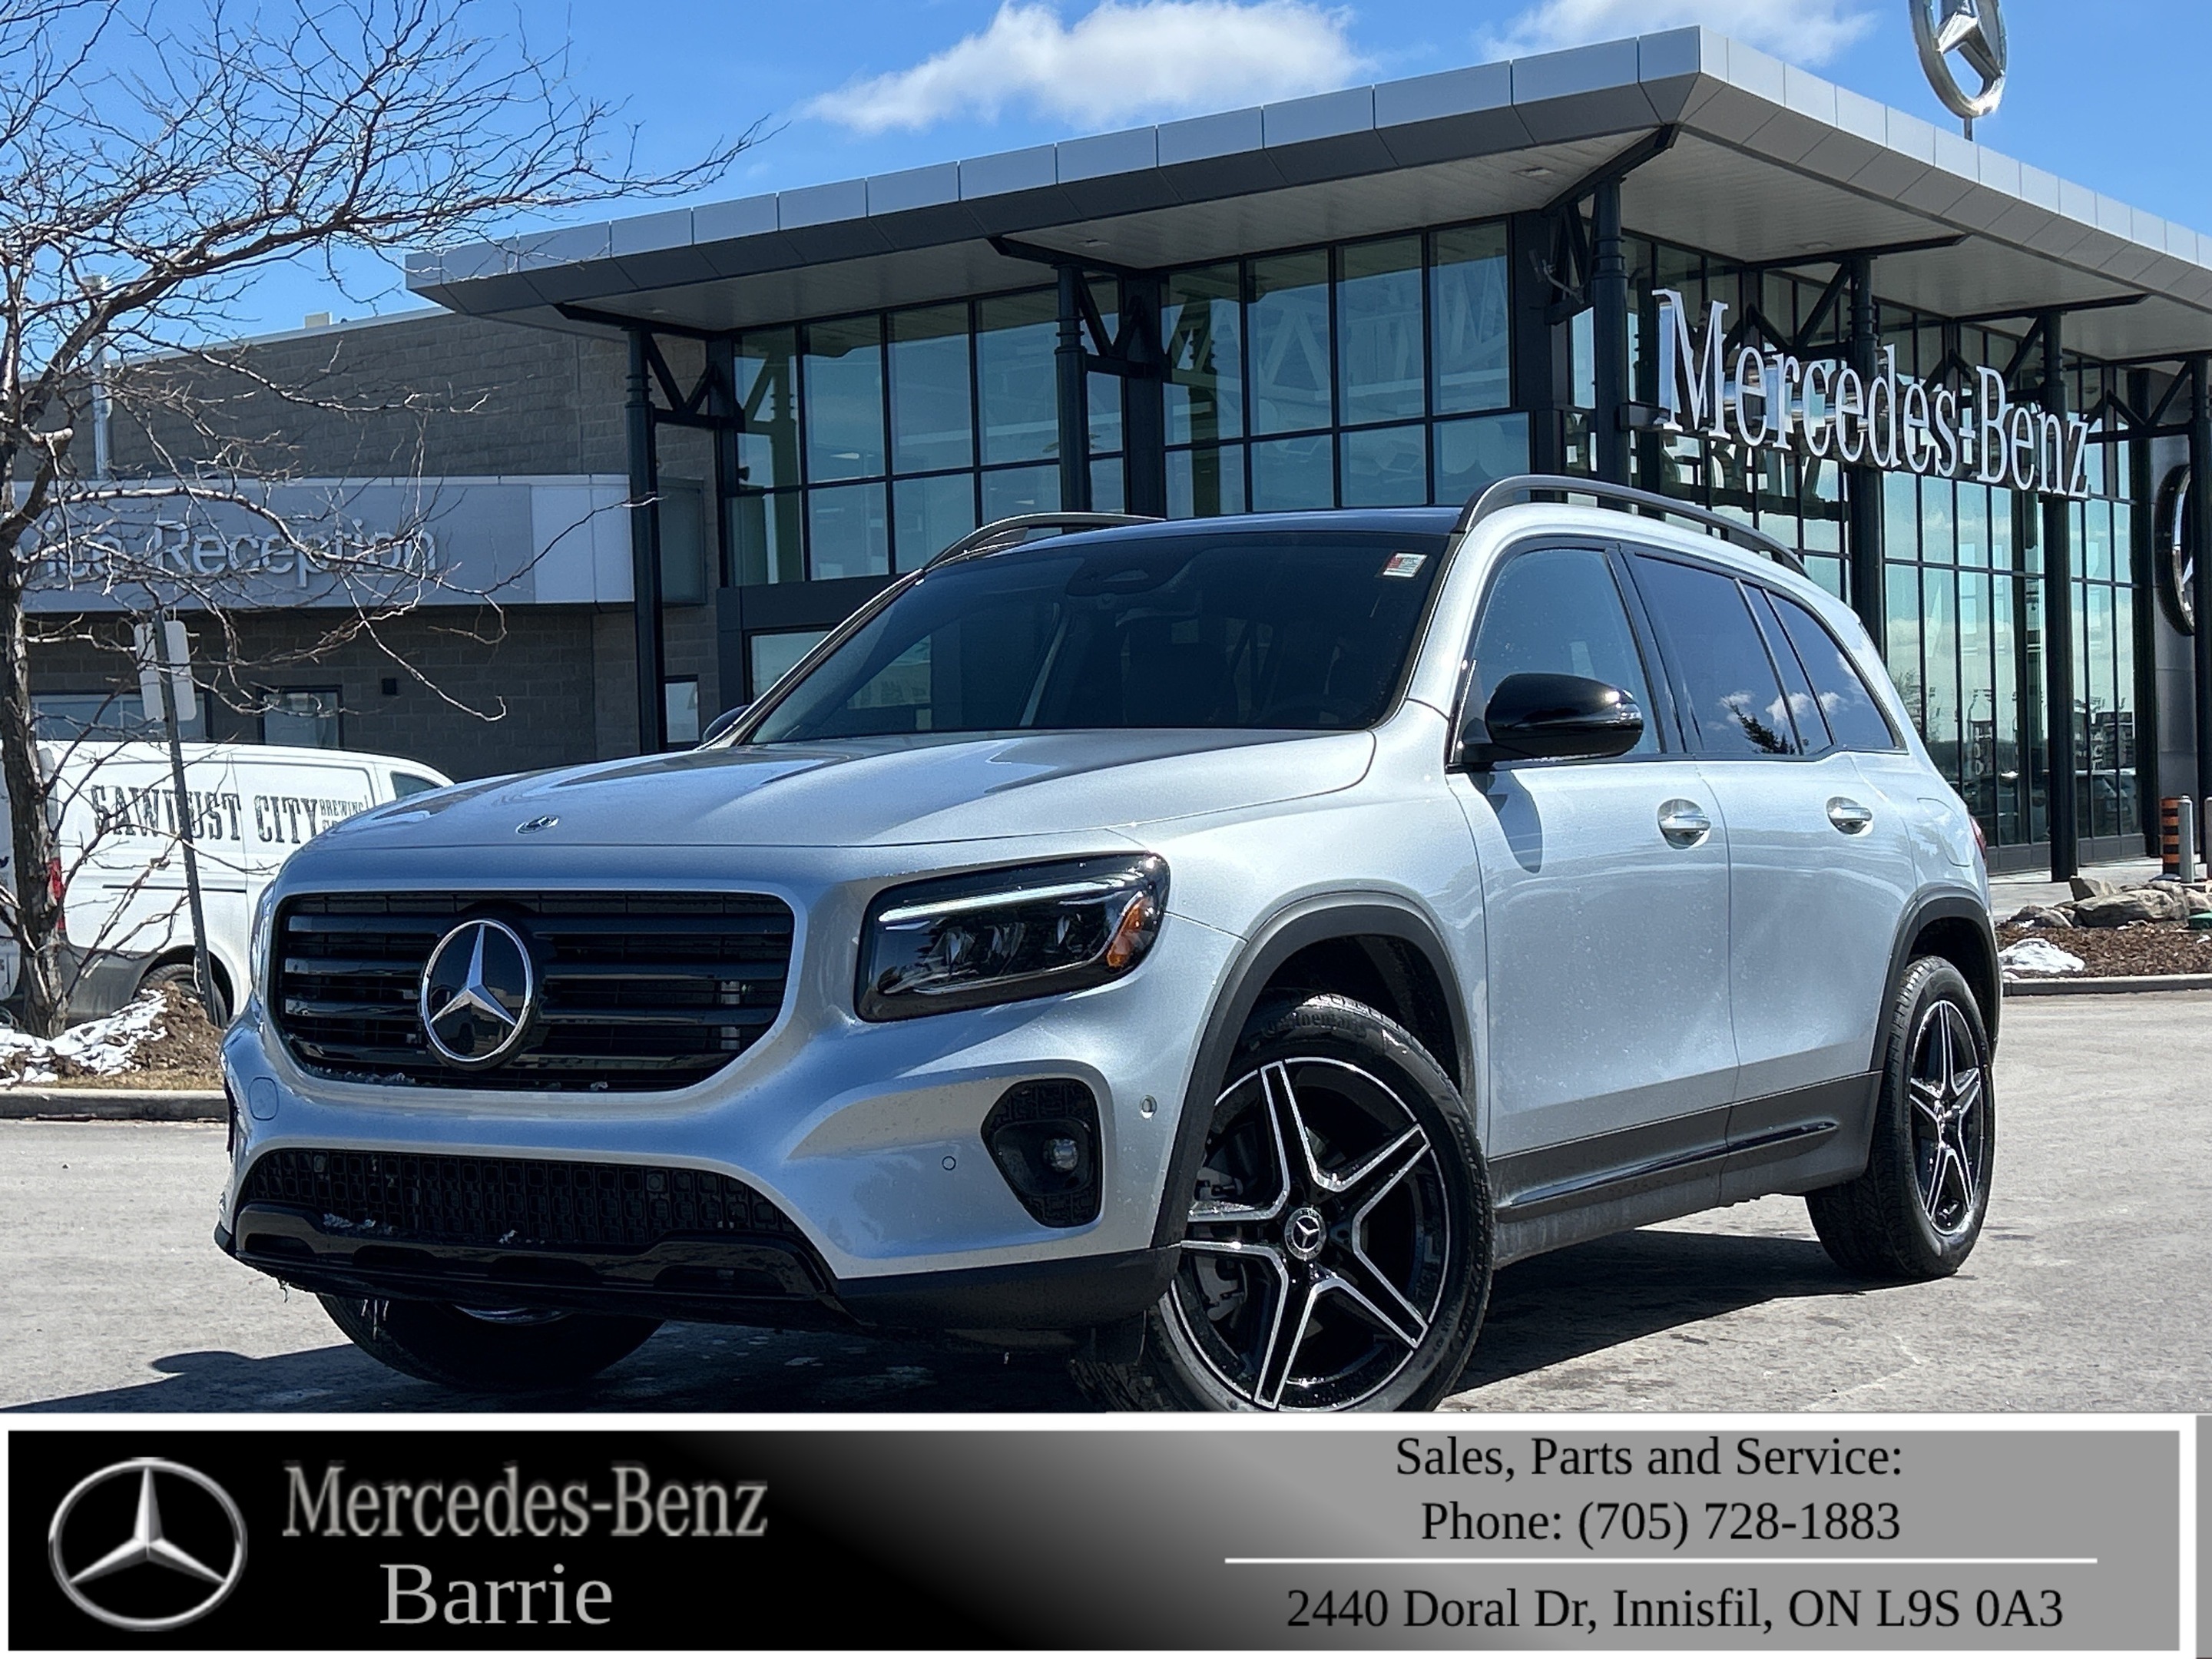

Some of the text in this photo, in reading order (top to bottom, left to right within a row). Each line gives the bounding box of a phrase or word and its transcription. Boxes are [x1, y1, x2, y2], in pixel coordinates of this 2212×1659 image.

[1651, 287, 2089, 499] Mercedes-Benz
[155, 518, 436, 588] Reception
[253, 794, 318, 844] CITY
